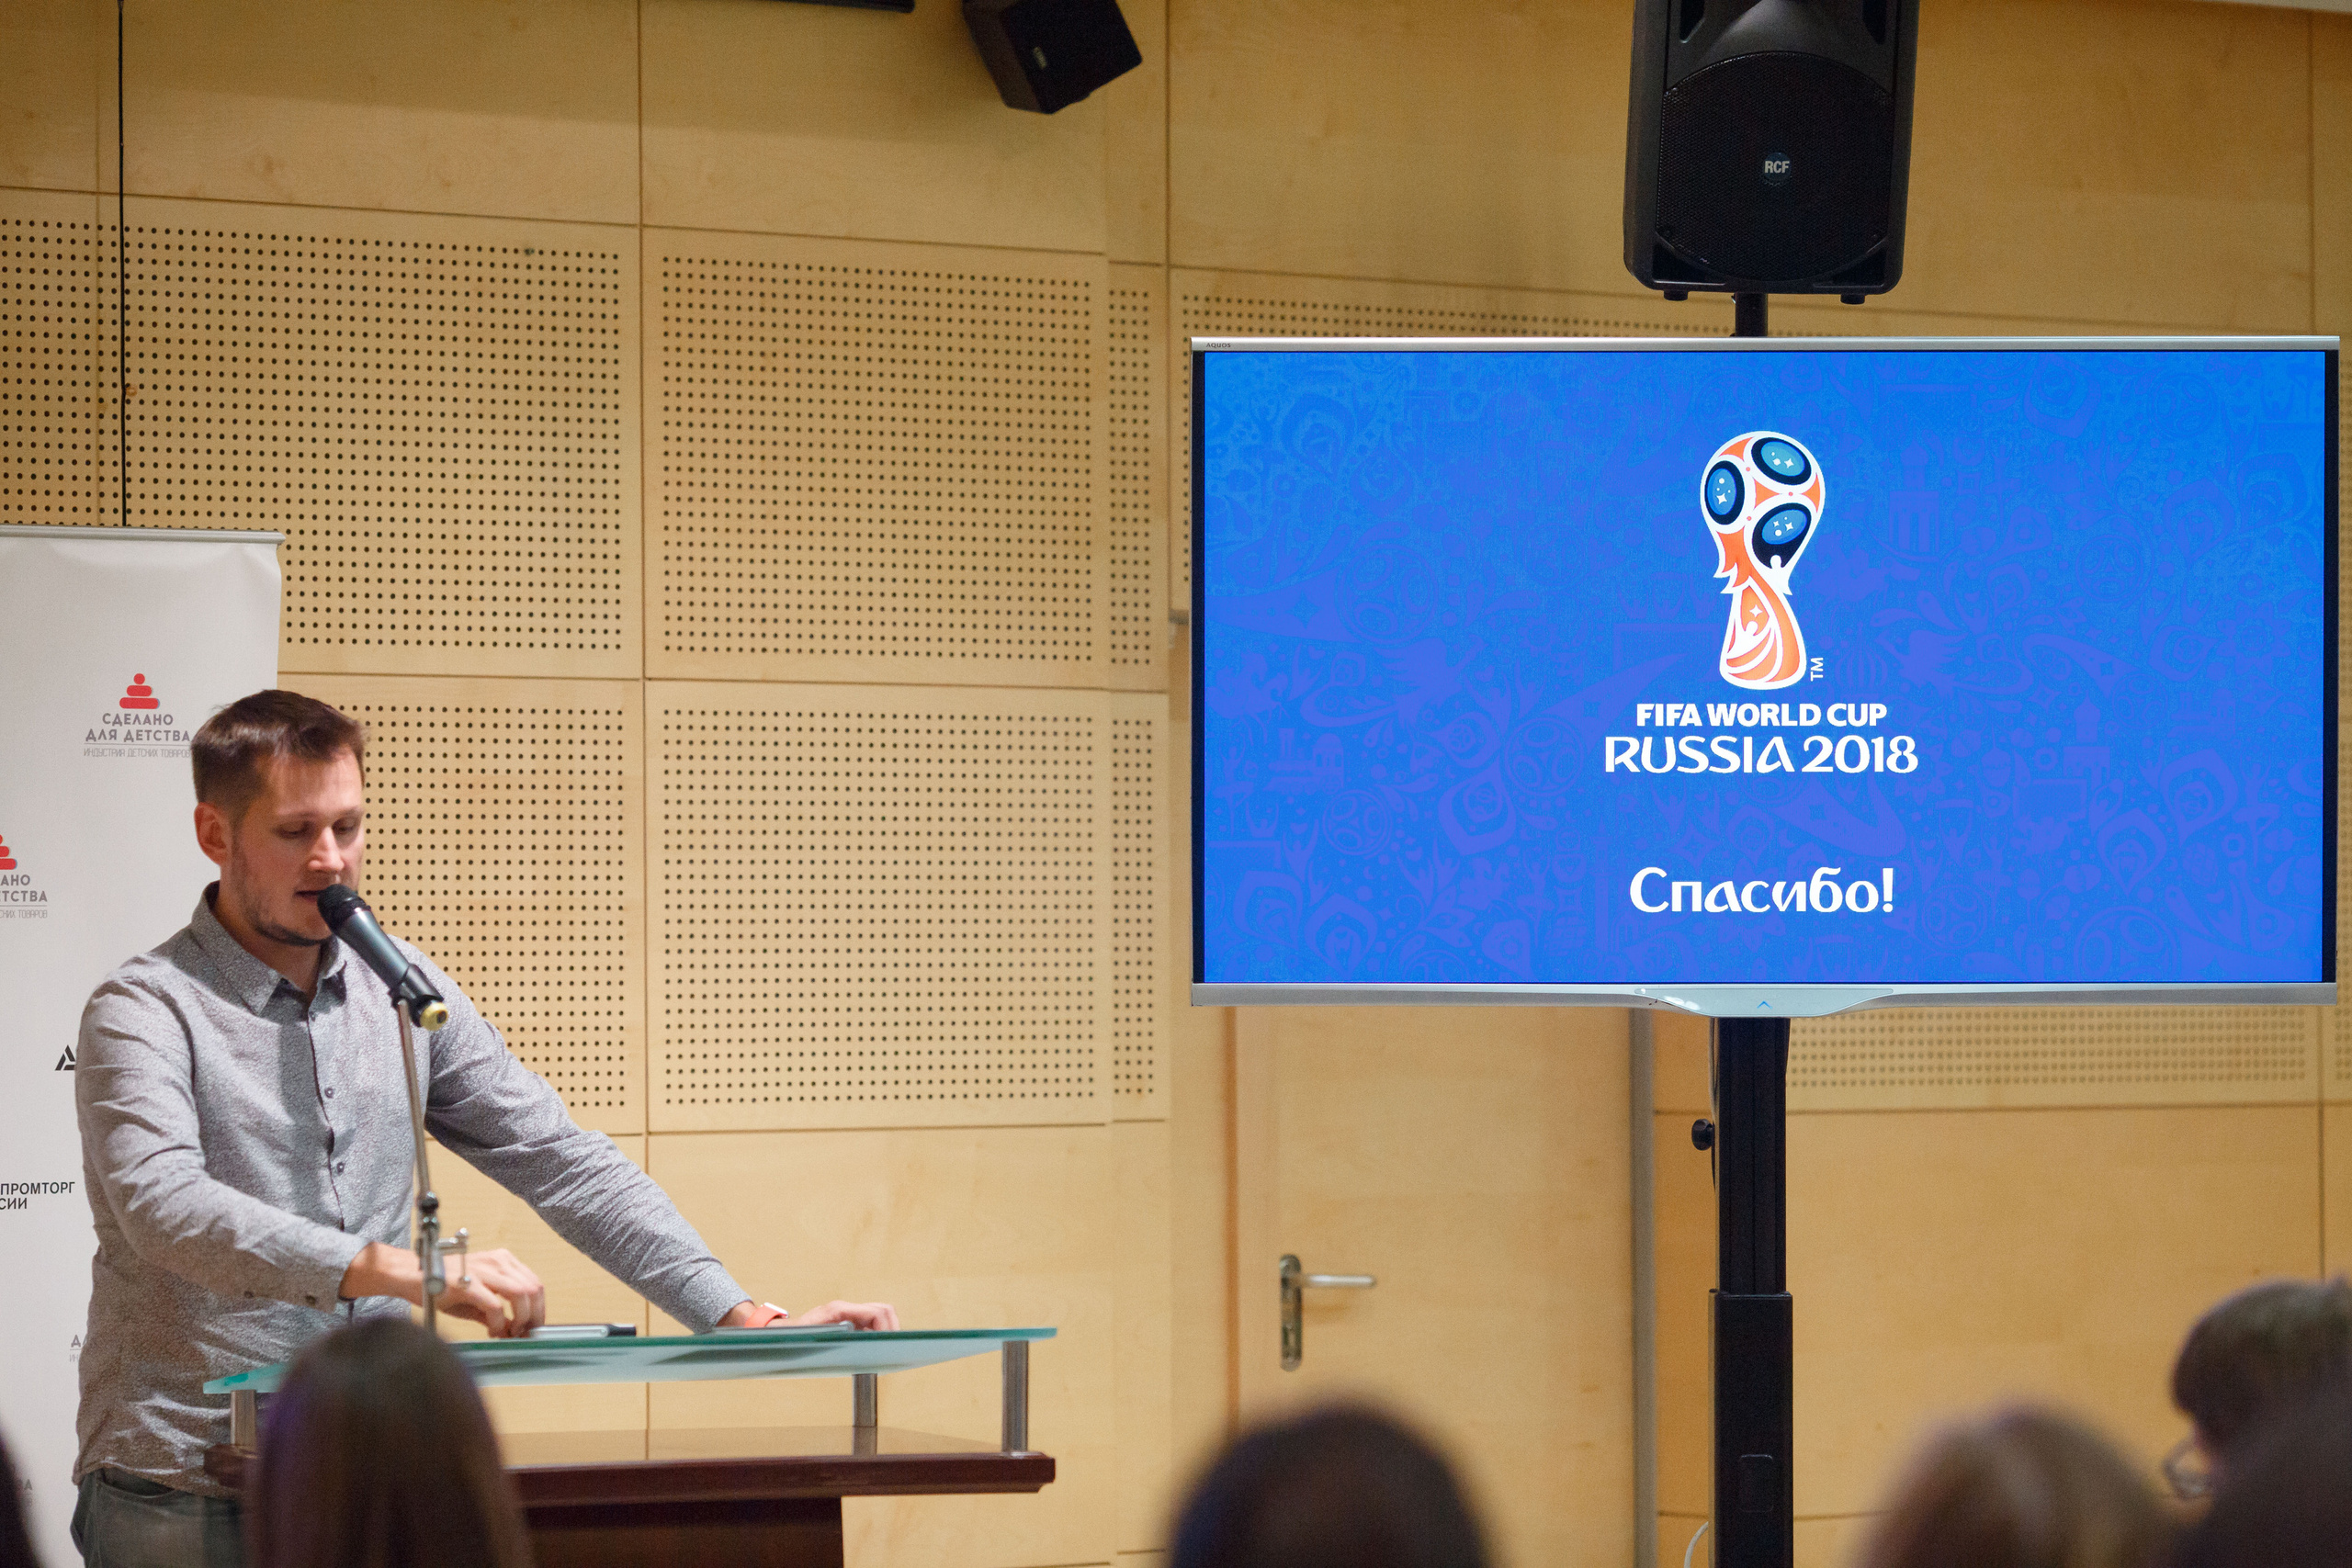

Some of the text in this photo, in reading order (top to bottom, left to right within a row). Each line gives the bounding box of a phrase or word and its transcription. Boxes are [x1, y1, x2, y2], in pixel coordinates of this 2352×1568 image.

[1764, 160, 1791, 174] RCF
[1811, 657, 1824, 682] TM
[102, 713, 174, 727] СДЕЛАНО
[1636, 703, 1888, 728] FIFA WORLD CUP
[85, 728, 190, 742] ДЛЯ ДЕТСТВА
[1605, 734, 1919, 774] RUSSIA 2018
[0, 874, 30, 886] АНО
[0, 890, 47, 902] ТСТВА
[1629, 866, 1894, 913] Спасибо!
